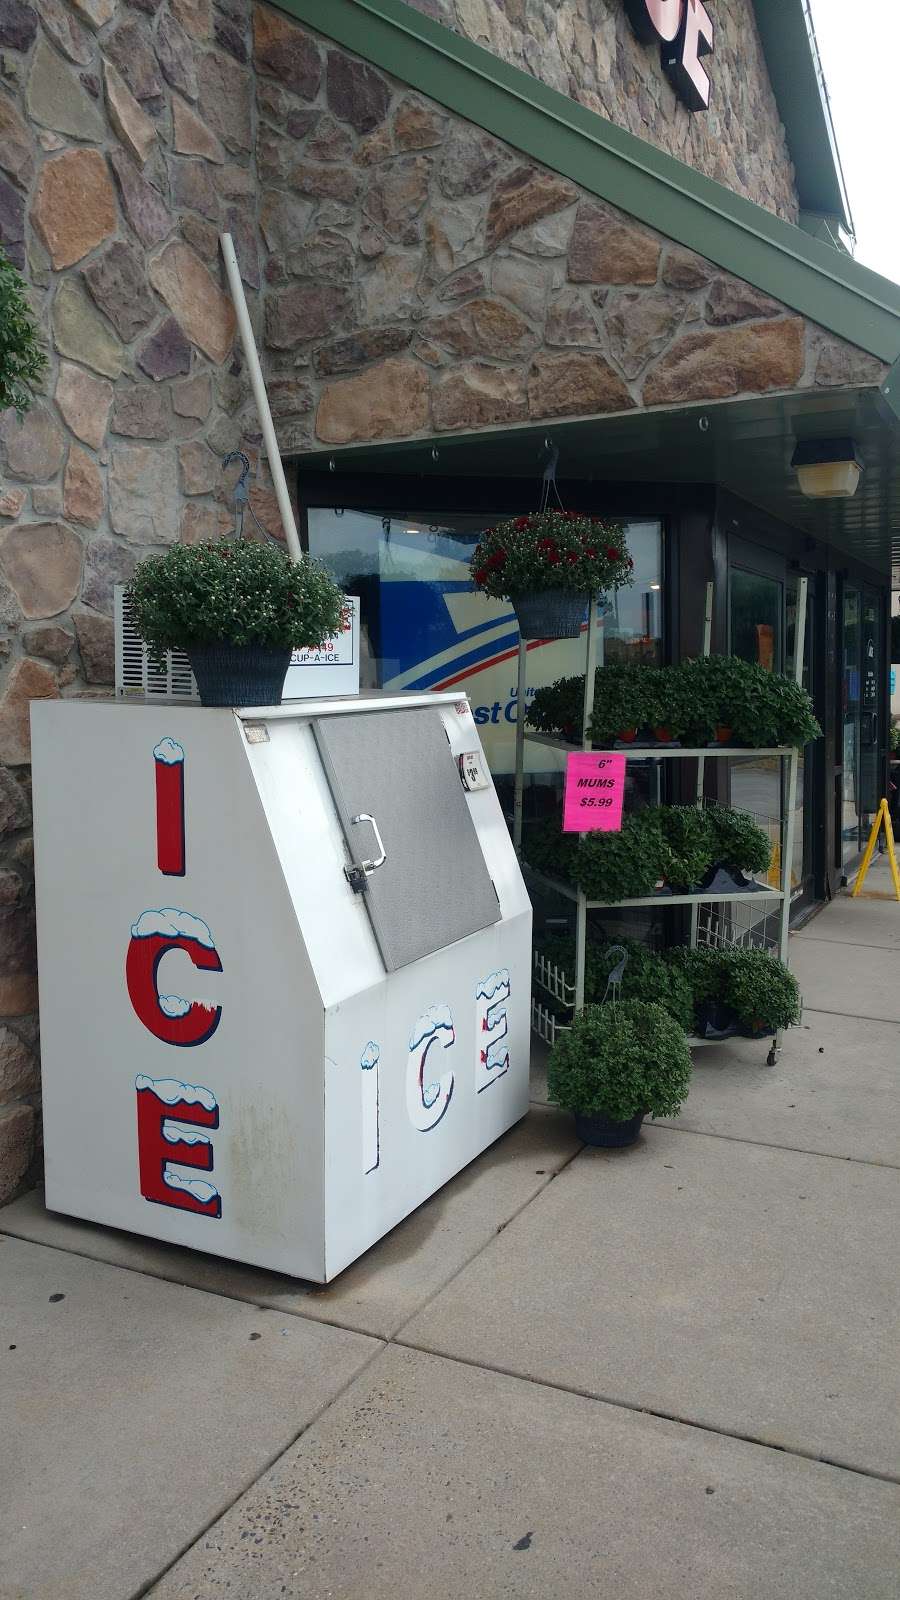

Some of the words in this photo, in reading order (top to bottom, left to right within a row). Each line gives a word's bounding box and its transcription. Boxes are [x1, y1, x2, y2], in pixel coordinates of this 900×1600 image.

[598, 759, 613, 769] 6"
[577, 778, 615, 789] MUMS
[580, 797, 613, 808] $5.99
